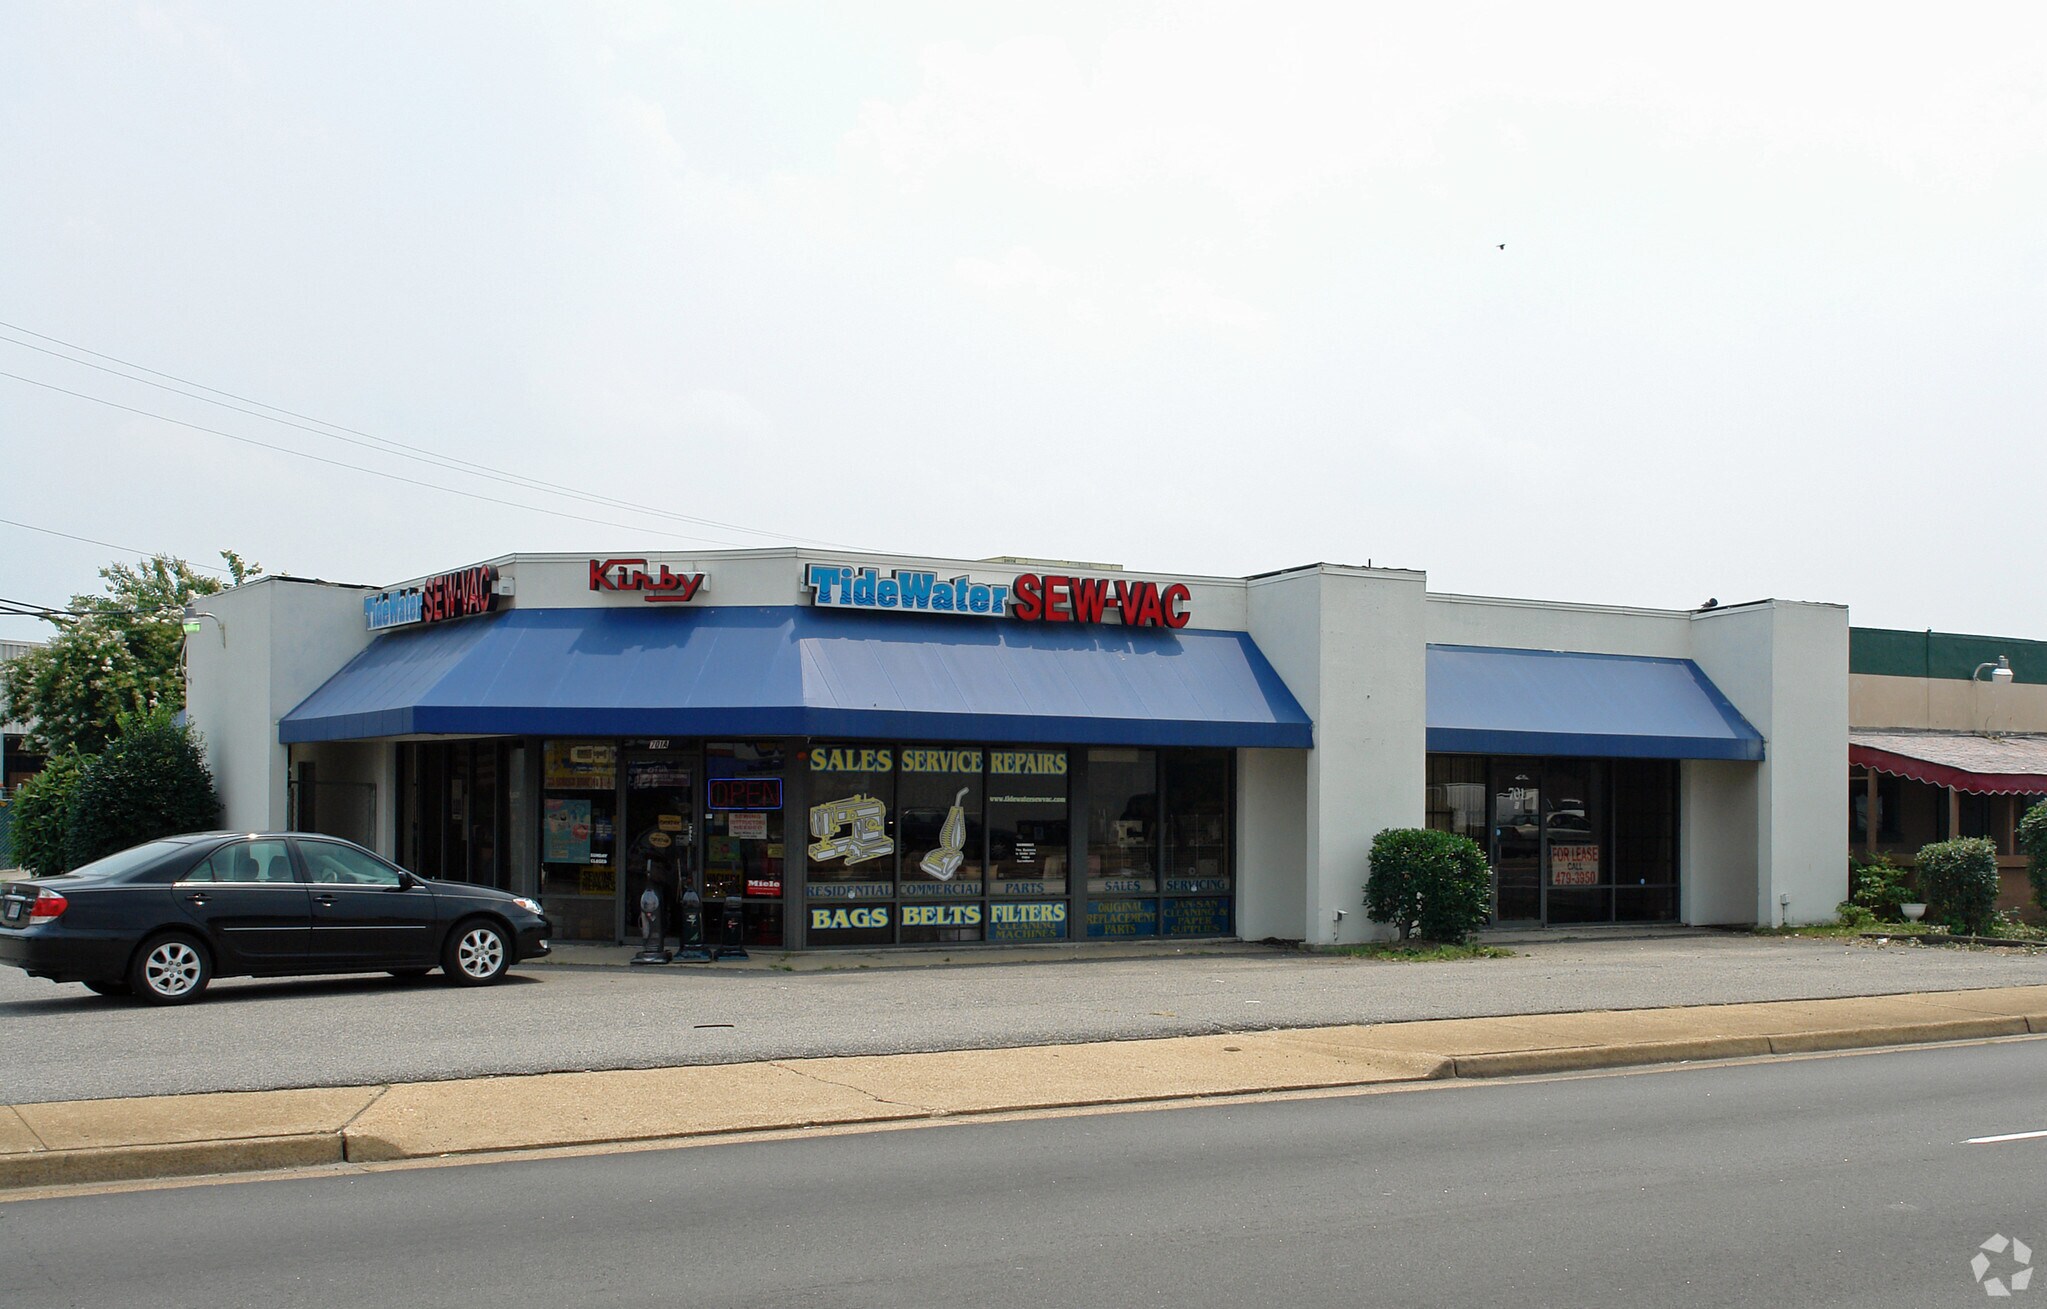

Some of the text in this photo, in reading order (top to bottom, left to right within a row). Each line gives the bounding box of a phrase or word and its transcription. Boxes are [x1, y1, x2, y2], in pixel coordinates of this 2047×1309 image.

[589, 559, 705, 603] Kirby
[423, 565, 497, 623] SEW-VAC
[810, 566, 1192, 629] TideWater SEW-VAC
[650, 740, 671, 750] 701A
[810, 749, 893, 773] SALES
[901, 751, 983, 773] SERVICE
[990, 752, 1067, 775] REPAIRS
[710, 782, 779, 807] OPEN
[1552, 847, 1598, 862] FOR LEASE
[1567, 862, 1583, 871] CALL
[747, 880, 780, 888] Miele
[1555, 871, 1596, 885] 479-3950
[806, 884, 892, 898] RESIDENTIAL
[900, 883, 981, 896] COMMERCIAL
[1005, 882, 1044, 894] PARTS
[1104, 880, 1141, 891] SALES
[1166, 879, 1225, 891] SERVICING
[990, 902, 1065, 924] FILTERS
[1098, 901, 1144, 912] ORIGINAL
[1163, 908, 1215, 917] CLEANING
[811, 908, 888, 929] BAGS
[901, 906, 982, 926] BELTS
[1087, 912, 1156, 924] REPLACEMENT
[1177, 917, 1212, 925] PAPER
[995, 929, 1056, 938] MACHINES
[1104, 924, 1136, 934] PARTS
